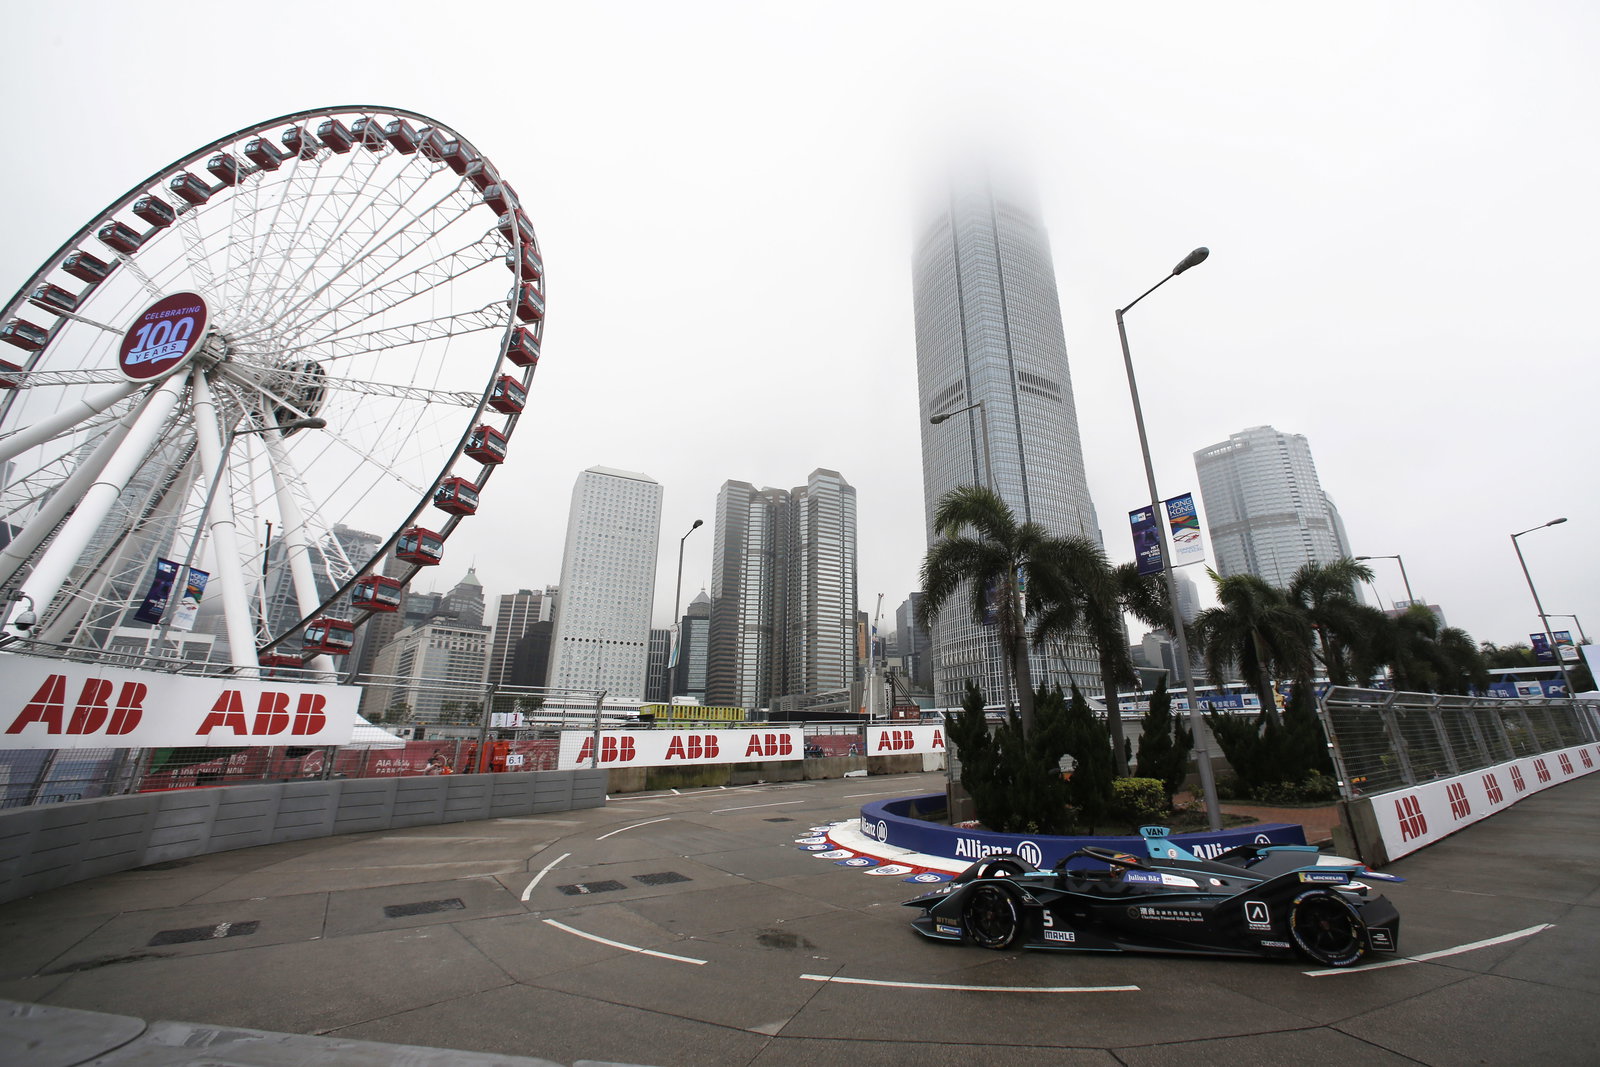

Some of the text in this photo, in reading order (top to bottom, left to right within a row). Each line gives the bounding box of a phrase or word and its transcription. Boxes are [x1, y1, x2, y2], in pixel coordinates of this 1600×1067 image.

[145, 305, 201, 320] CELEBRATING
[130, 317, 194, 352] 100
[135, 343, 177, 361] YEARS
[1168, 497, 1192, 510] HONG
[1170, 504, 1194, 516] KONG
[6, 674, 147, 735] ABB
[196, 690, 327, 736] ABB
[576, 736, 636, 763] ABB
[666, 735, 720, 760] ABB
[746, 733, 793, 756] ABB
[878, 730, 914, 750] ABB
[1557, 753, 1574, 775] ABB
[1578, 748, 1594, 769] ABB
[1508, 765, 1526, 793] ABB
[1532, 758, 1552, 783] ABB
[1482, 773, 1503, 805] ABB
[1446, 782, 1471, 821] ABB
[1394, 795, 1428, 843] ABB
[1146, 828, 1164, 836] VAN
[1128, 874, 1147, 882] Julius
[1043, 909, 1054, 927] 5
[1044, 930, 1074, 942] MAHLE
